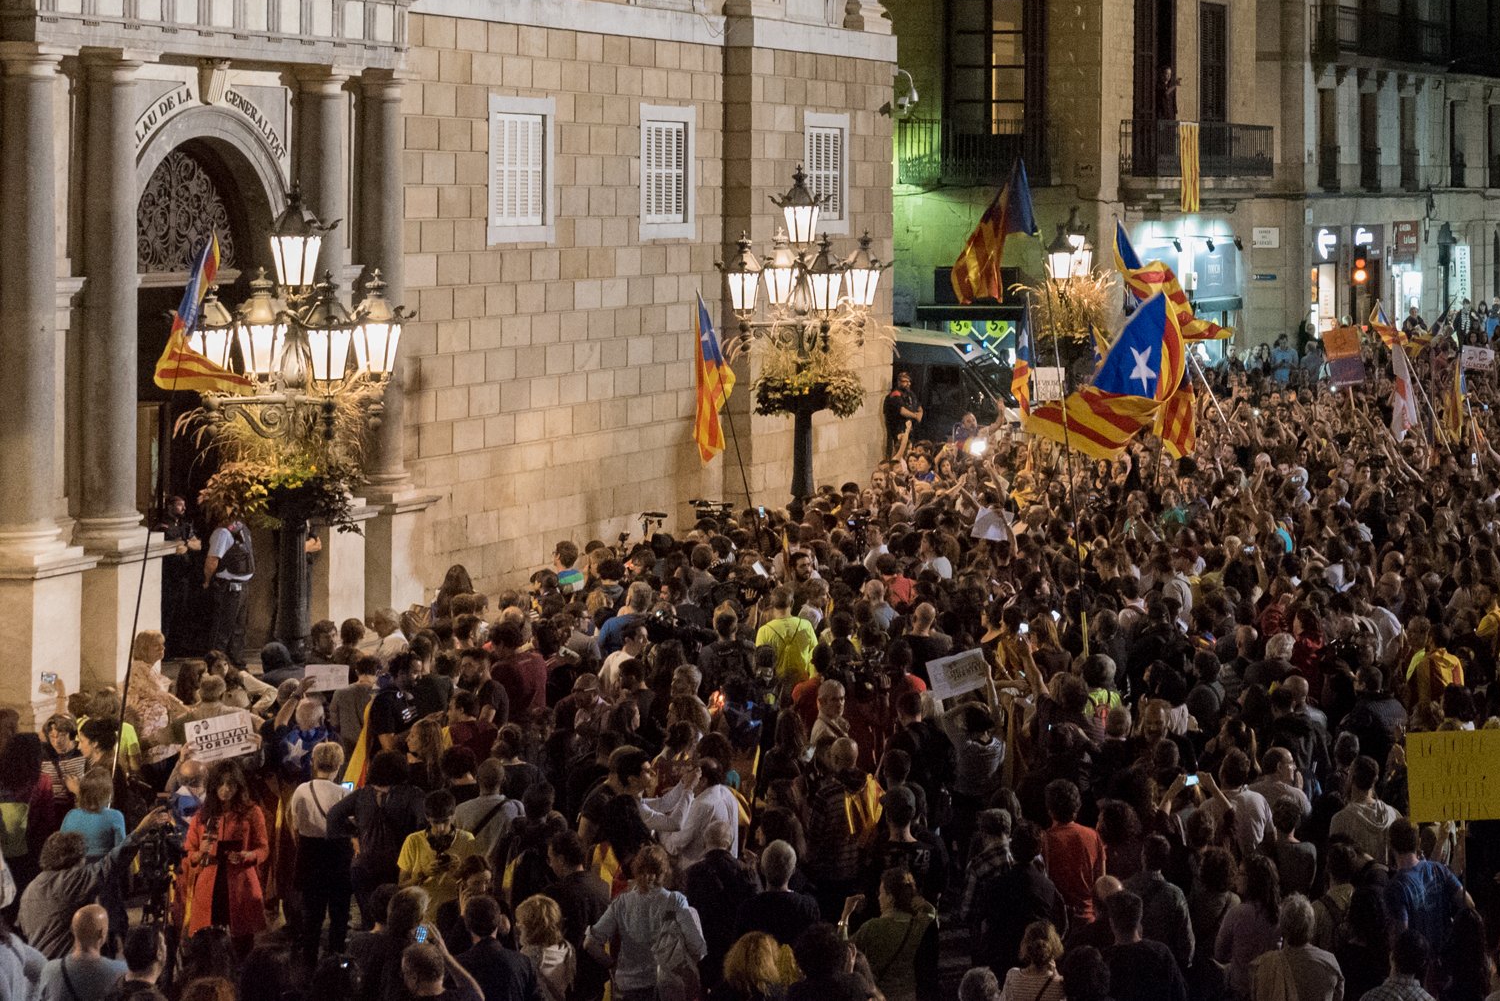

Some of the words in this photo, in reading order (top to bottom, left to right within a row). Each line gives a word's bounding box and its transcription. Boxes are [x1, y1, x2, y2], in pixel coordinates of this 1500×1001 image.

[135, 113, 158, 149] LAU
[158, 96, 176, 117] DE
[177, 87, 193, 105] LA
[224, 89, 286, 161] GENERALITAT
